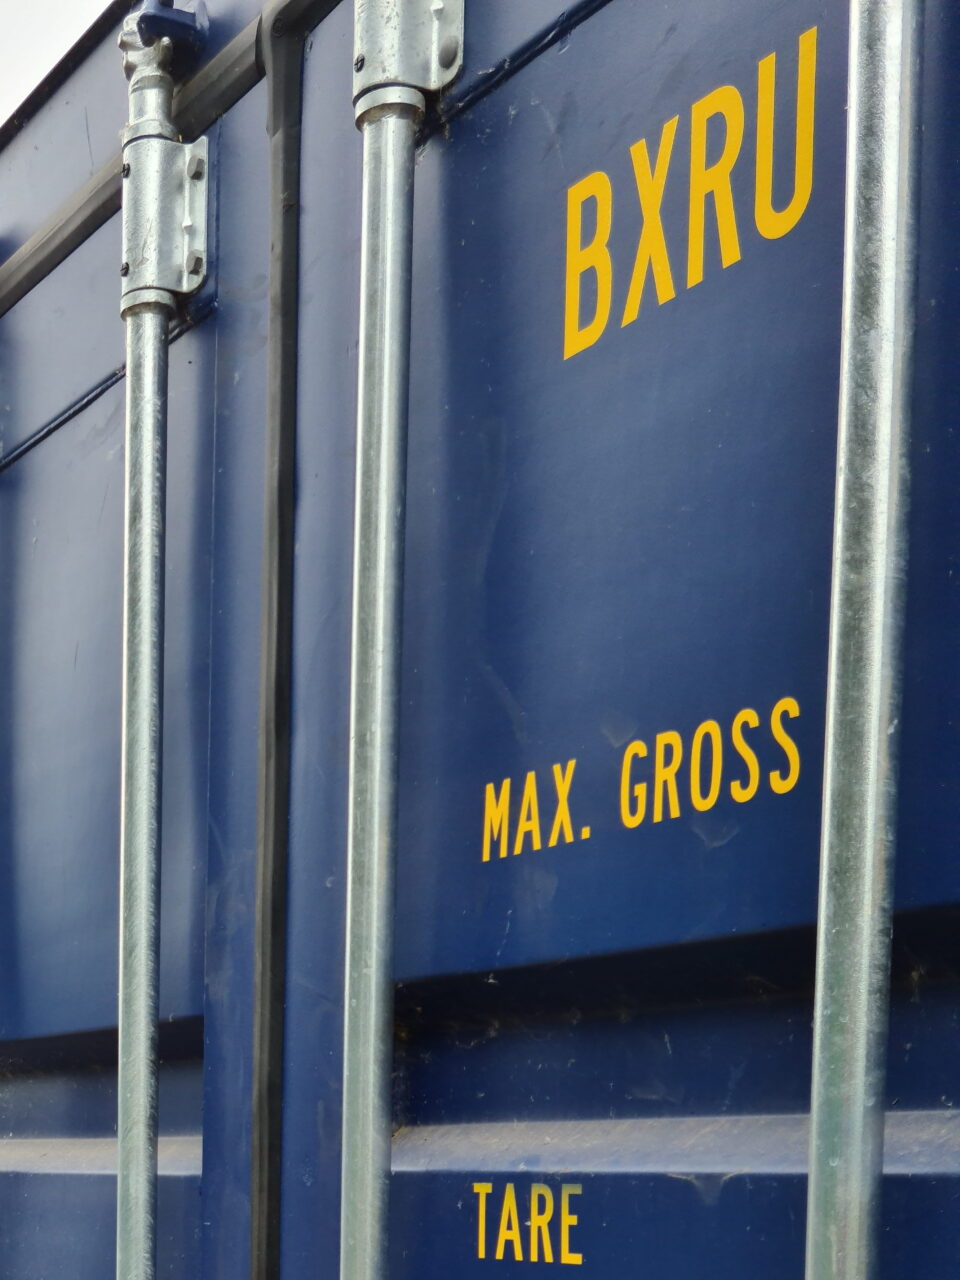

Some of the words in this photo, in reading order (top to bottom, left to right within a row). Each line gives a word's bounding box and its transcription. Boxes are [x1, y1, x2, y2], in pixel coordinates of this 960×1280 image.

[563, 25, 818, 361] BXRU
[482, 757, 591, 863] MAX.
[620, 696, 802, 829] GROSS
[472, 1182, 583, 1265] TARE
